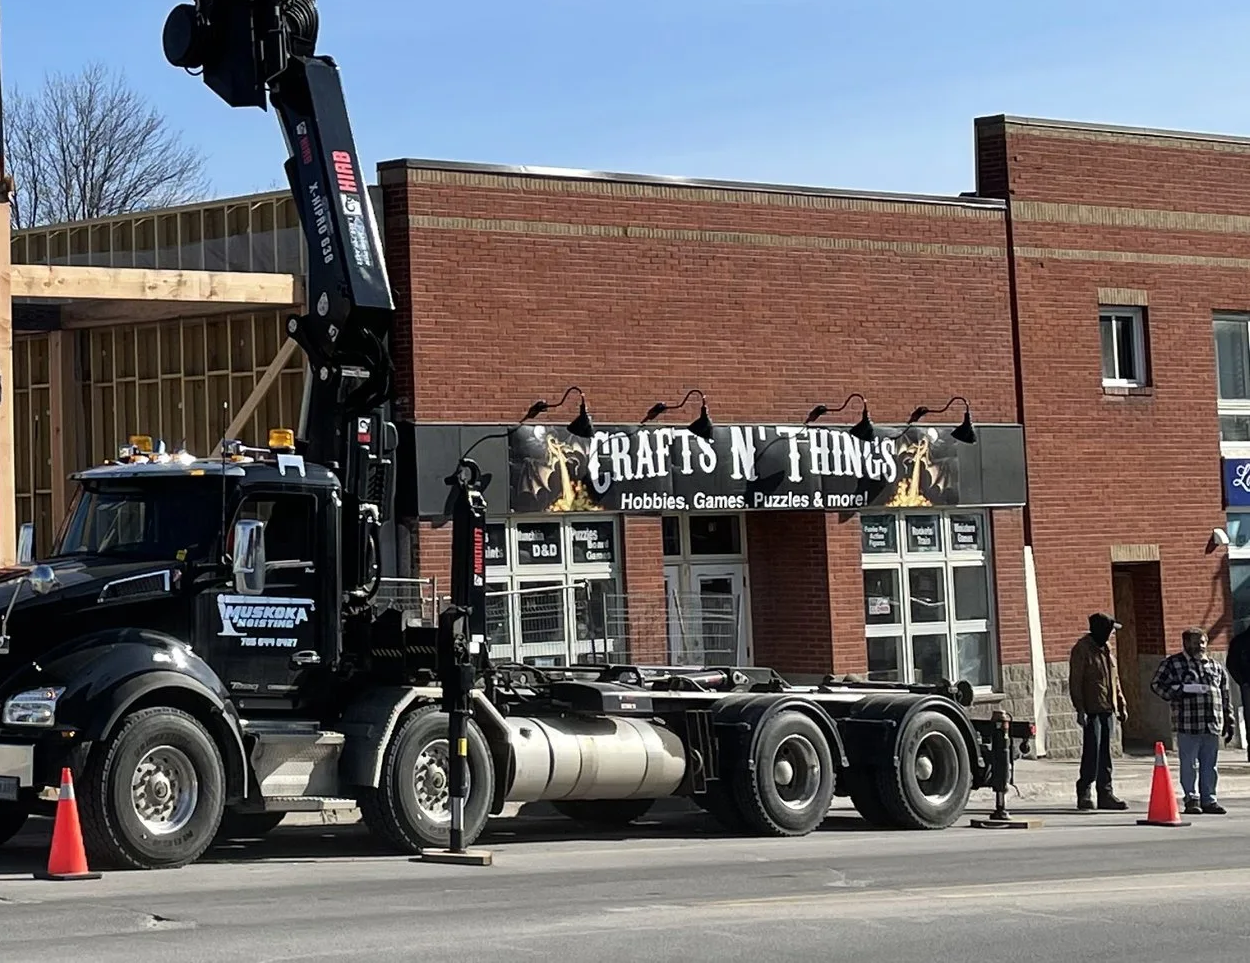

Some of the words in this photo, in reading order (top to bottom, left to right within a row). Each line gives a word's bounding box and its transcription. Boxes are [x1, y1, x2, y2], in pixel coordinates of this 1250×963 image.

[332, 150, 357, 193] HIAB
[309, 182, 327, 235] X-HIPRO
[587, 427, 718, 494] CRAFTS
[729, 425, 766, 482] N'
[775, 425, 898, 484] THINGS
[620, 491, 690, 511] Hobbies,
[693, 491, 749, 511] Games,
[753, 491, 810, 509] Puzzles
[813, 491, 825, 508] &
[827, 490, 869, 508] more!
[473, 527, 484, 575] MULTILIFT
[532, 543, 558, 558] D&D
[224, 605, 309, 625] MUSKOKA
[237, 619, 294, 628] HOISTING
